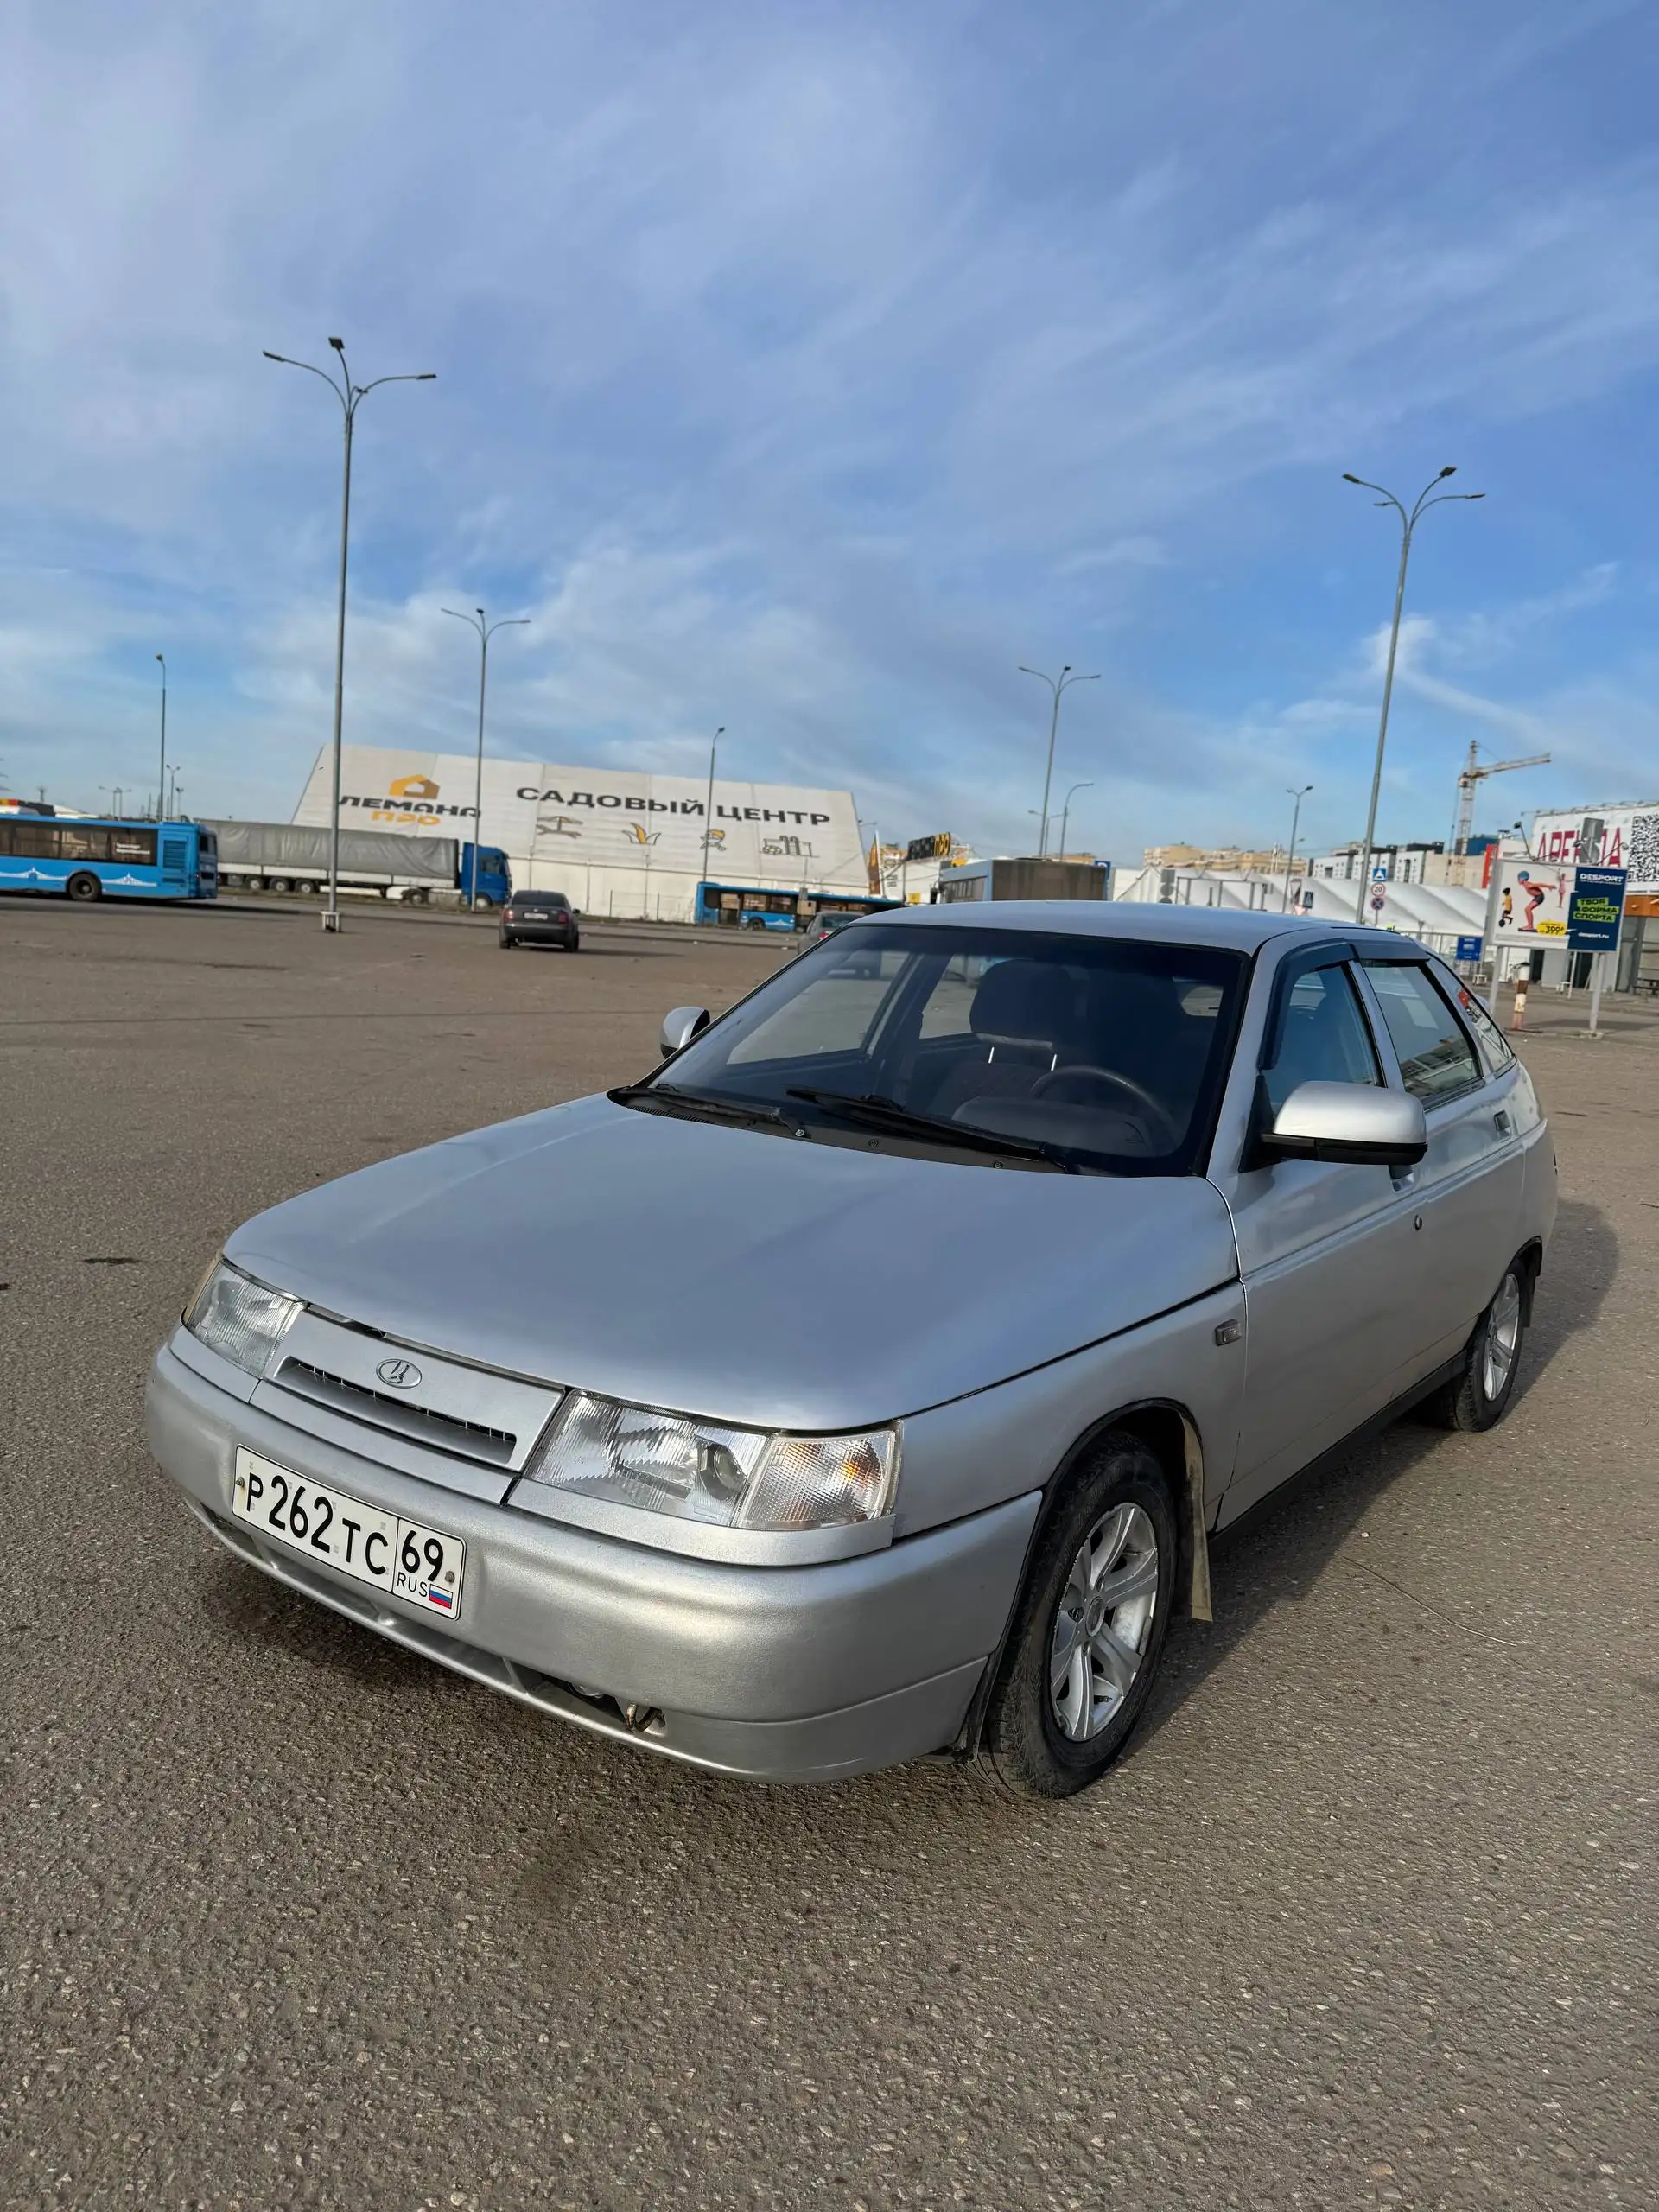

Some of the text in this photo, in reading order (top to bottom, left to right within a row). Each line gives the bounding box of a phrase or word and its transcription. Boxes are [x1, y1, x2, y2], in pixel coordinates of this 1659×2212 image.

[339, 795, 481, 817] ЛЕМАНА
[517, 787, 830, 826] САДОВЫЙ ЦЕНТР
[371, 810, 440, 826] ПРО
[1580, 873, 1623, 882] DESPORT
[402, 1530, 443, 1581] 69
[397, 1572, 428, 1597] RUS
